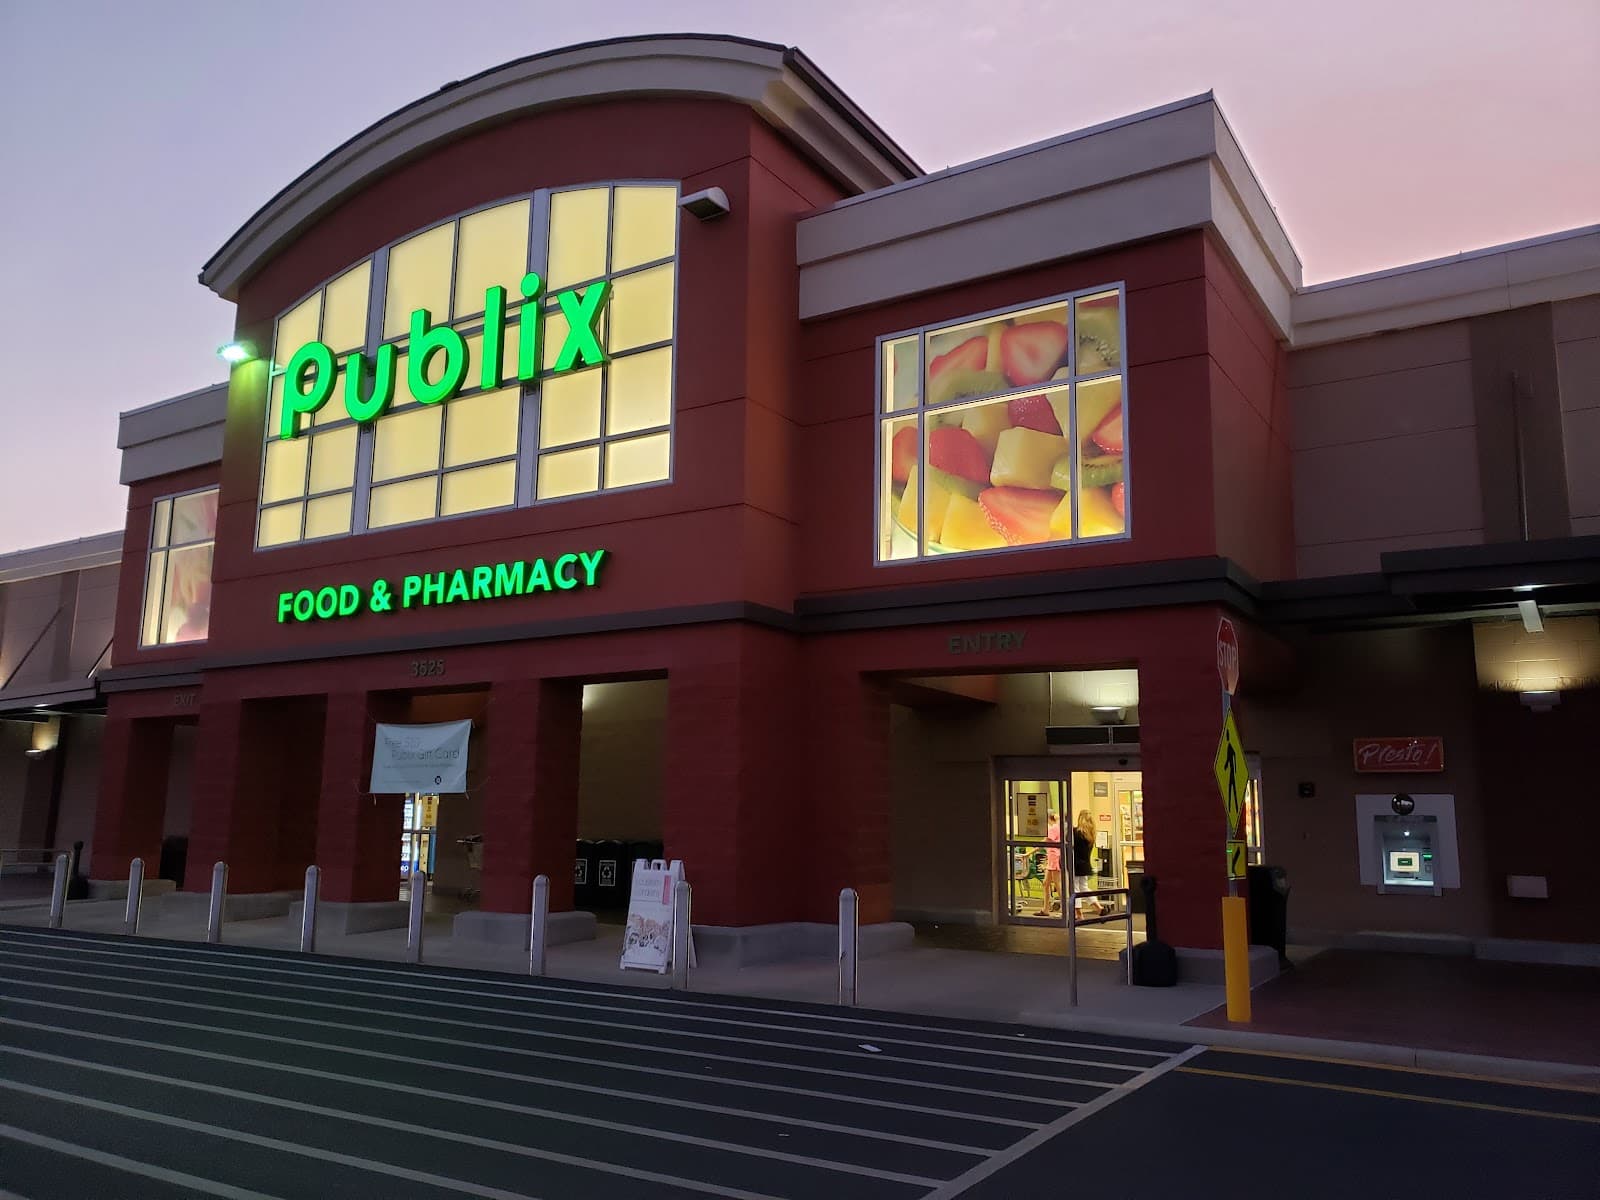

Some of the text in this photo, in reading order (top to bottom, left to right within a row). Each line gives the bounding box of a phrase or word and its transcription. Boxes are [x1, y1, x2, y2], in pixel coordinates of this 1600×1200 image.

[280, 272, 611, 440] Publix
[277, 549, 605, 623] FOOD & PHARMACY
[949, 630, 1026, 655] ENTRY
[1219, 640, 1237, 670] STOP
[410, 659, 445, 676] 3625
[1358, 742, 1438, 765] Presto!
